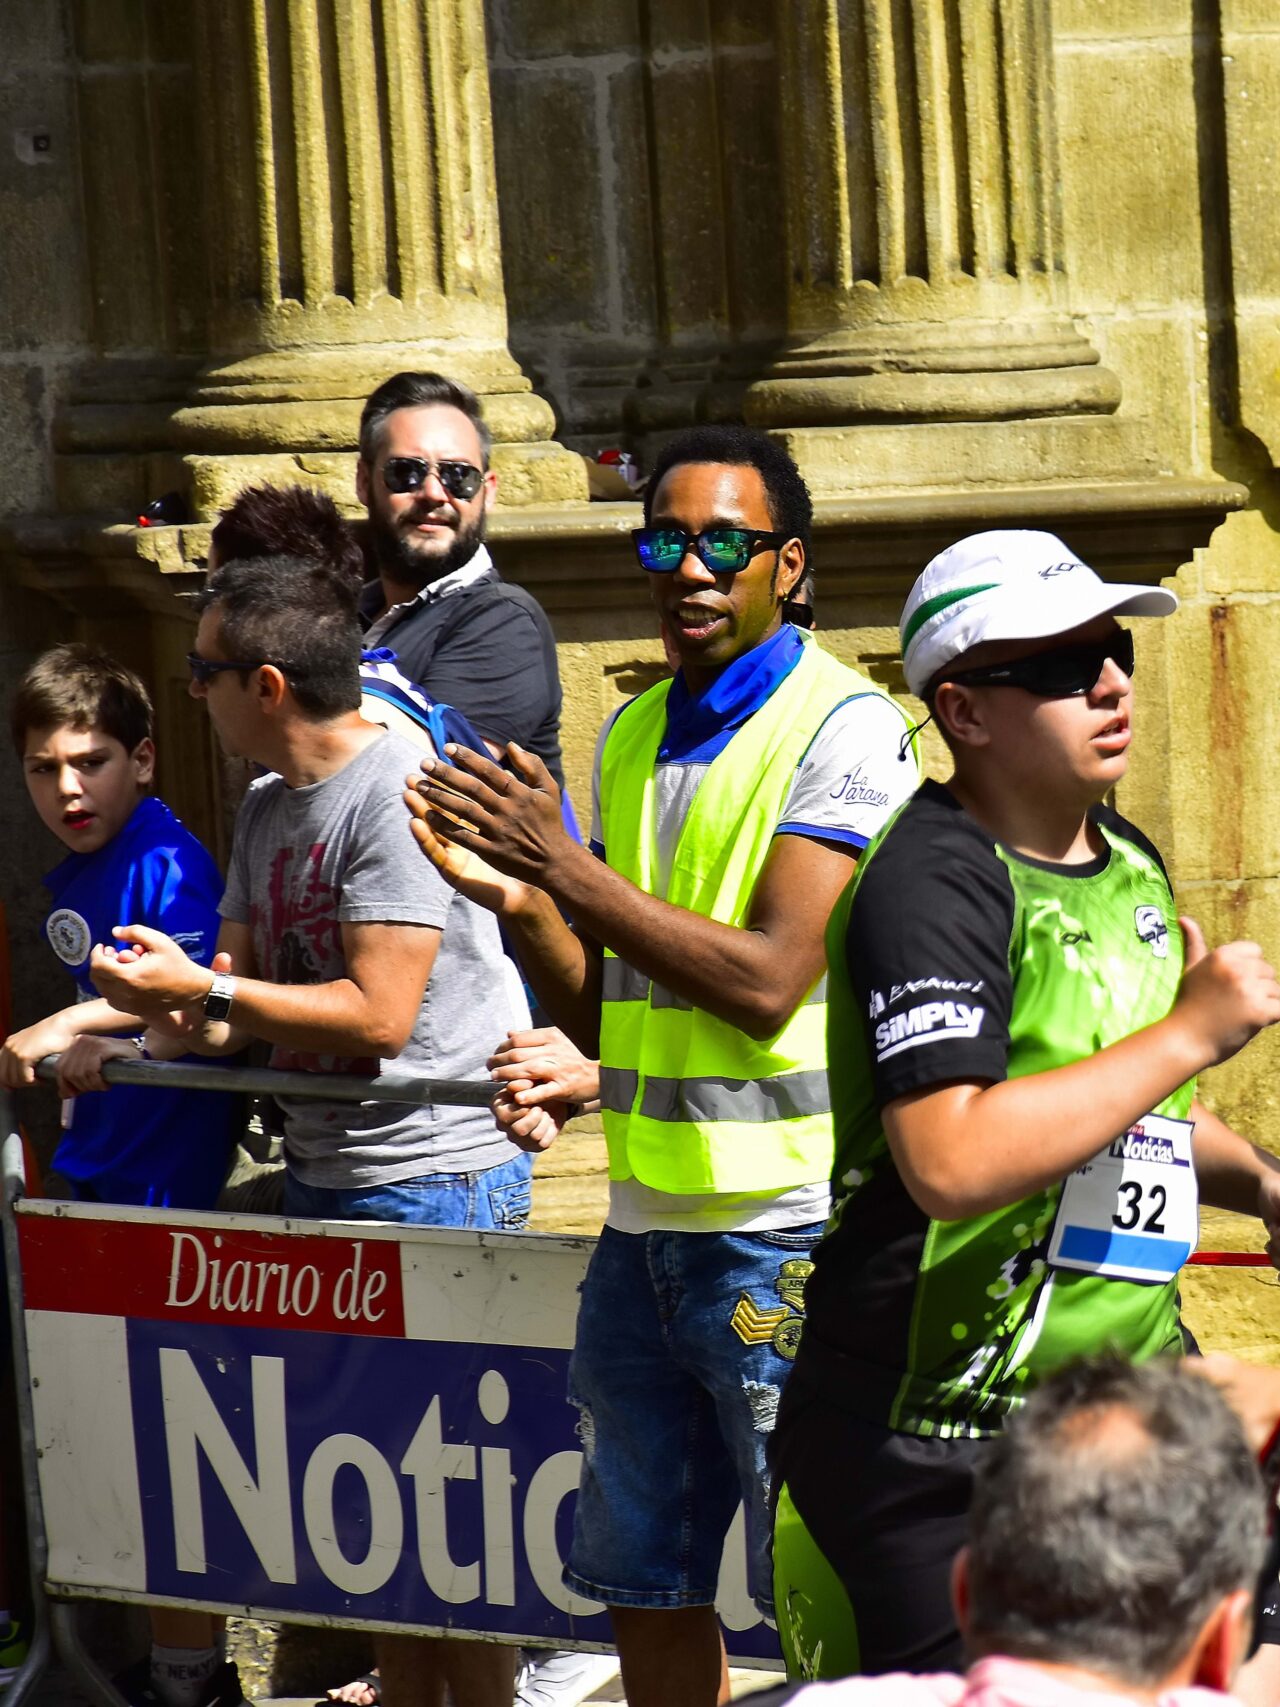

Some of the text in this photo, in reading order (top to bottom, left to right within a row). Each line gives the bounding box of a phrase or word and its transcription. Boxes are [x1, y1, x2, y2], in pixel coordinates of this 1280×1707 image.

[851, 766, 868, 785] La
[1113, 1133, 1173, 1163] Noticias
[1112, 1181, 1167, 1234] 32
[165, 1232, 386, 1321] Diario de
[157, 1347, 776, 1632] Notic
